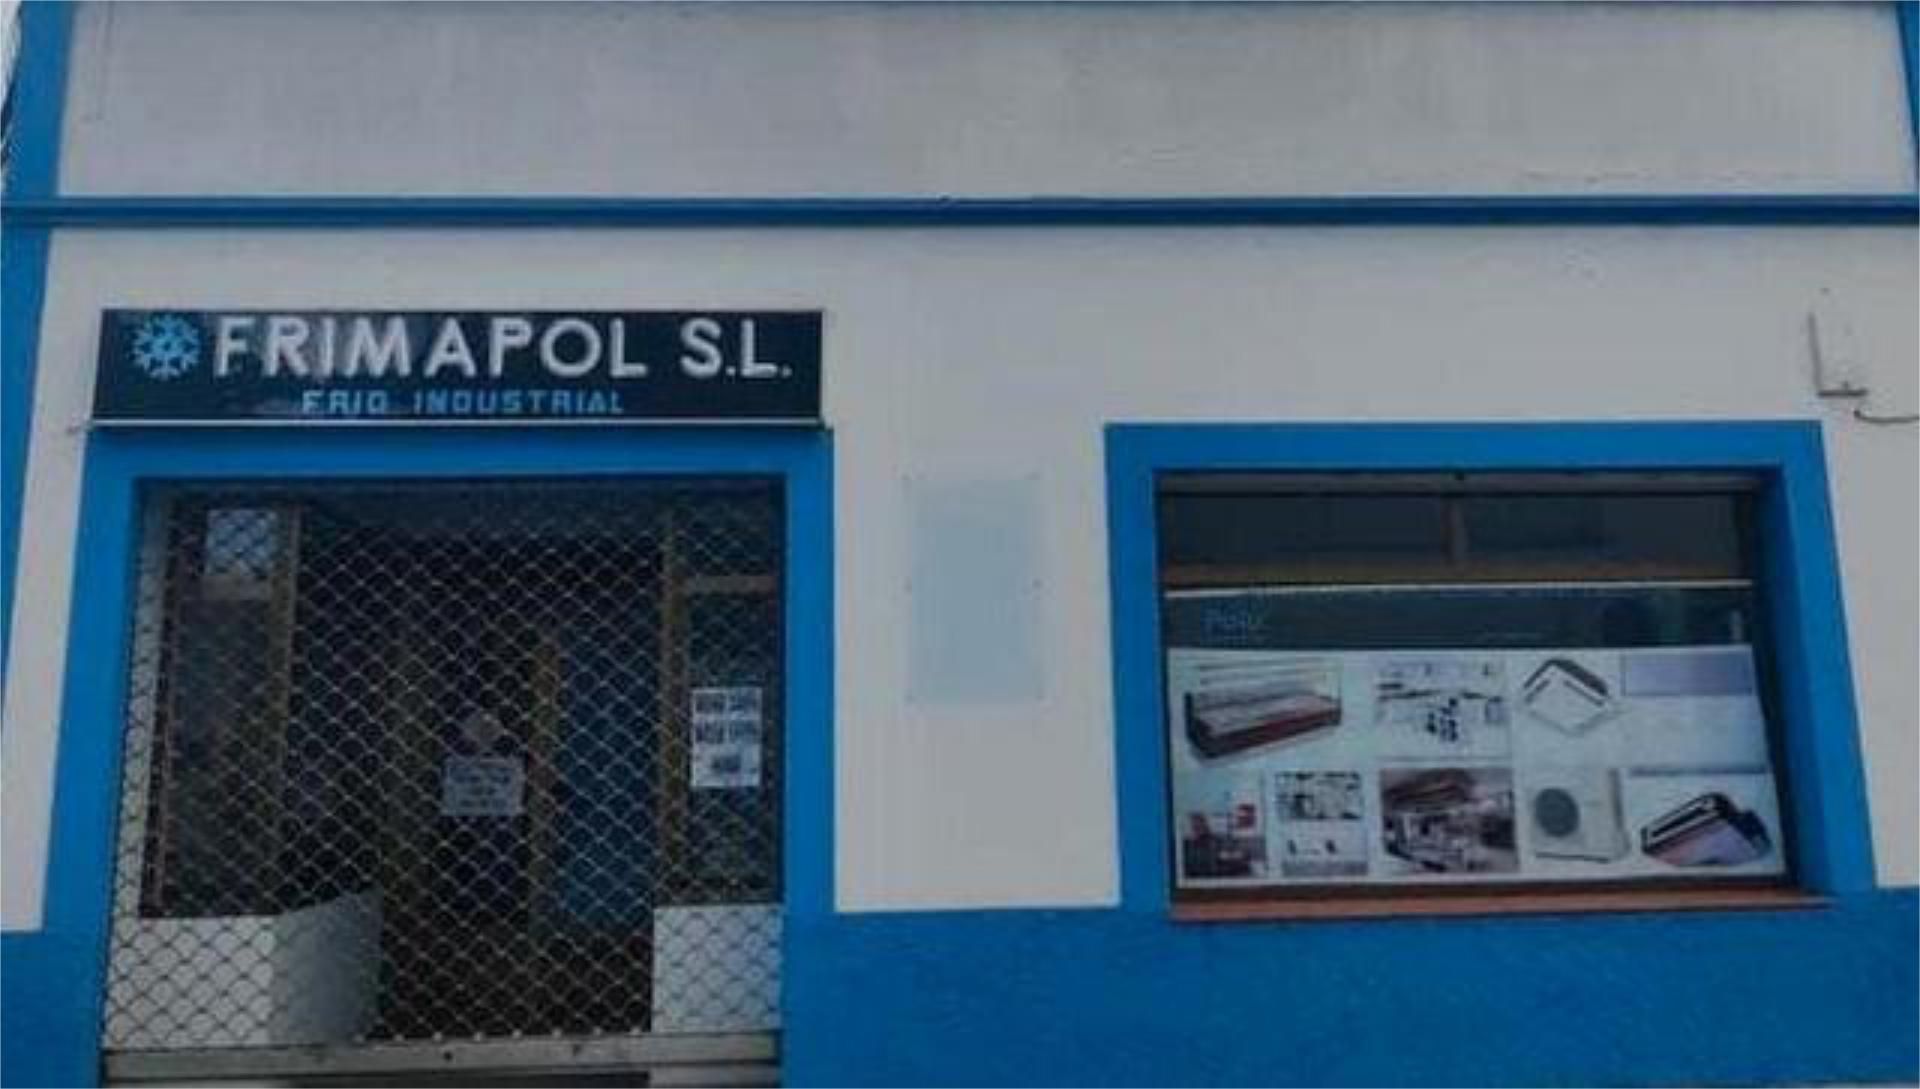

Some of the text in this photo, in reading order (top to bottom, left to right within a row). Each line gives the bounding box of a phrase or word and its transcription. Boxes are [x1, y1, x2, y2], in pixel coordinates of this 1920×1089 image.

[214, 316, 792, 378] FRIMAPOL S.L.
[302, 390, 624, 414] FRIO INDUSTRIAL
